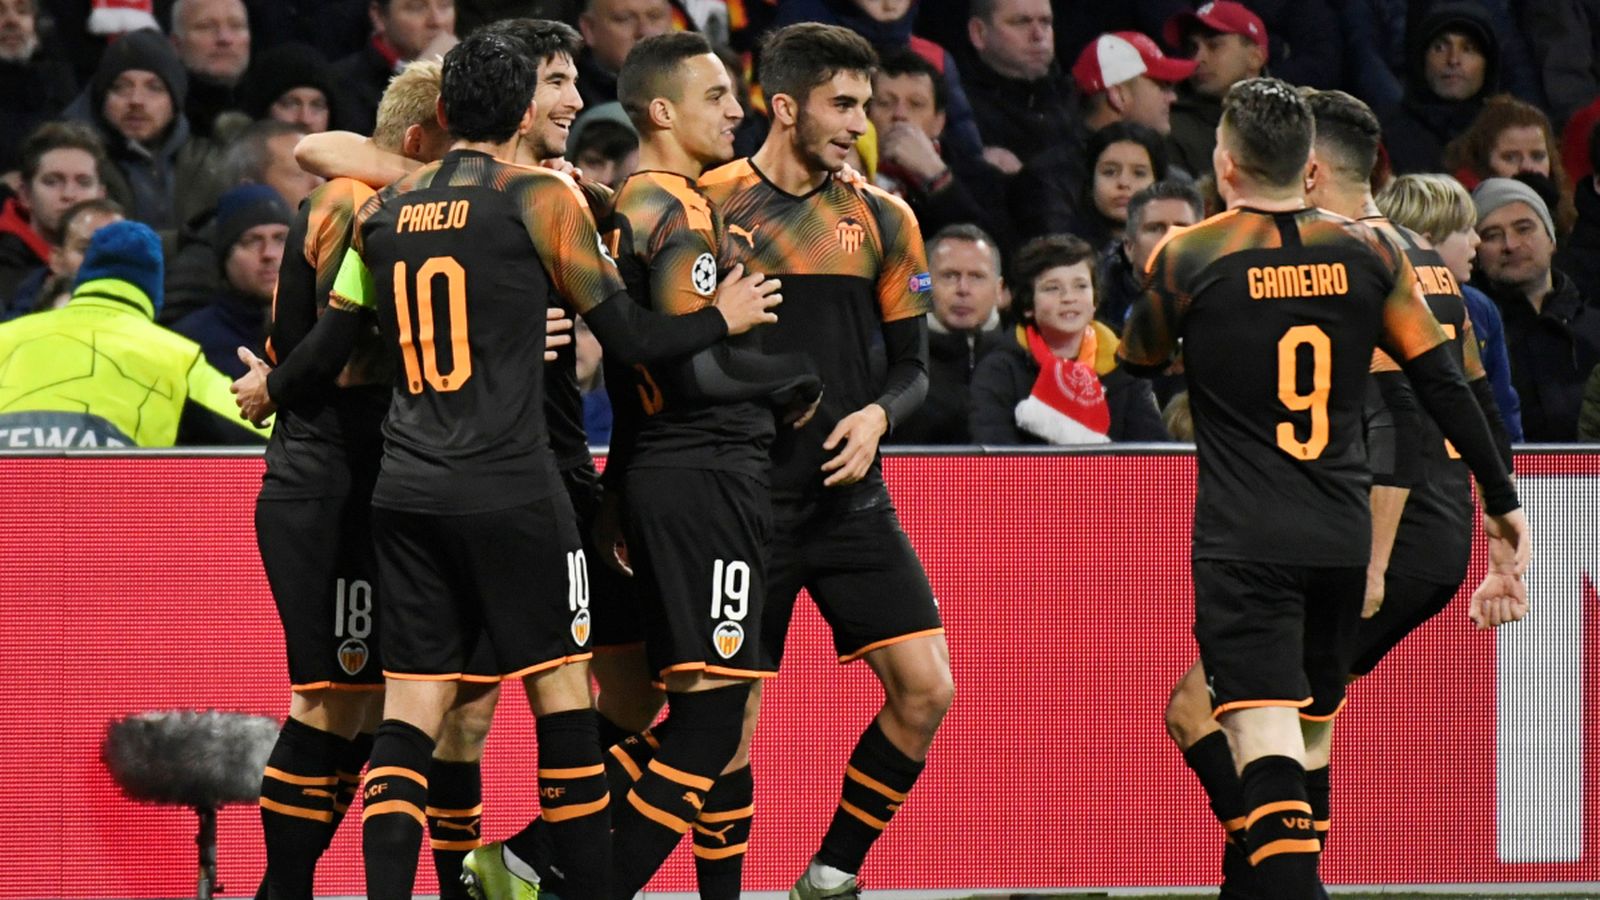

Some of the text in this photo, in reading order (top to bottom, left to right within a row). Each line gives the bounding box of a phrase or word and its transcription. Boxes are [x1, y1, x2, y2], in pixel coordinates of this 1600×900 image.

[397, 200, 469, 234] PAREJO
[1247, 263, 1348, 299] GAMEIRO
[394, 256, 472, 394] 10
[1276, 324, 1331, 460] 9
[567, 548, 589, 611] 10
[711, 559, 750, 621] 19
[335, 578, 372, 639] 18
[364, 782, 388, 800] VCF
[540, 786, 566, 799] VCF
[1282, 816, 1312, 830] VCF
